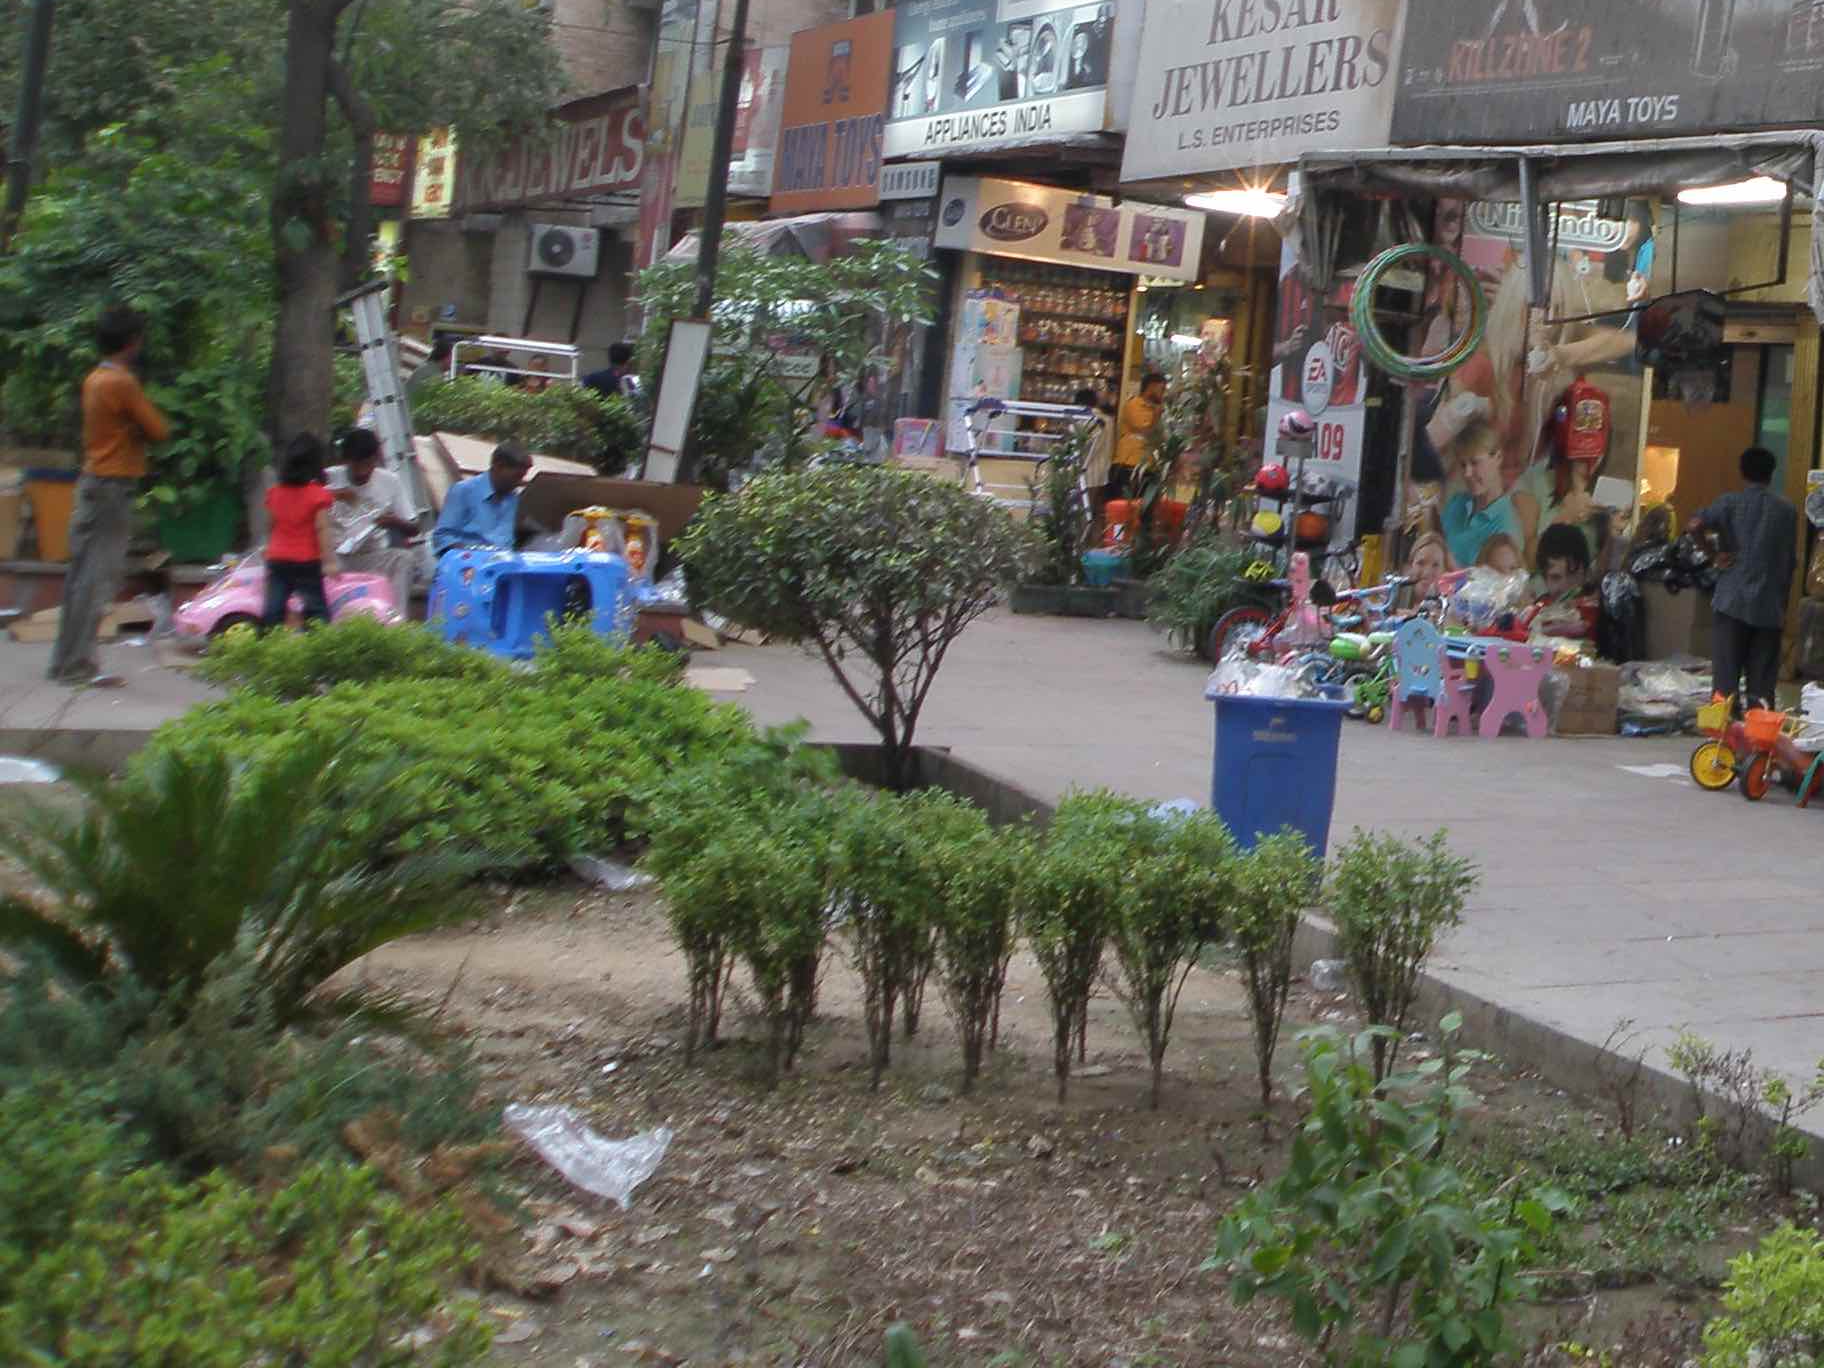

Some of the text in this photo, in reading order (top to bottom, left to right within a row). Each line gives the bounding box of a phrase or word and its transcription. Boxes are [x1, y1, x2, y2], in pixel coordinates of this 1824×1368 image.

[1153, 34, 1390, 120] JEWELLERS
[925, 104, 1052, 145] APPLIANCES INDIA
[1178, 110, 1340, 151] L.S. ENTERPRISES
[1567, 94, 1679, 129] MAYA TOYS
[1319, 422, 1345, 461] 09
